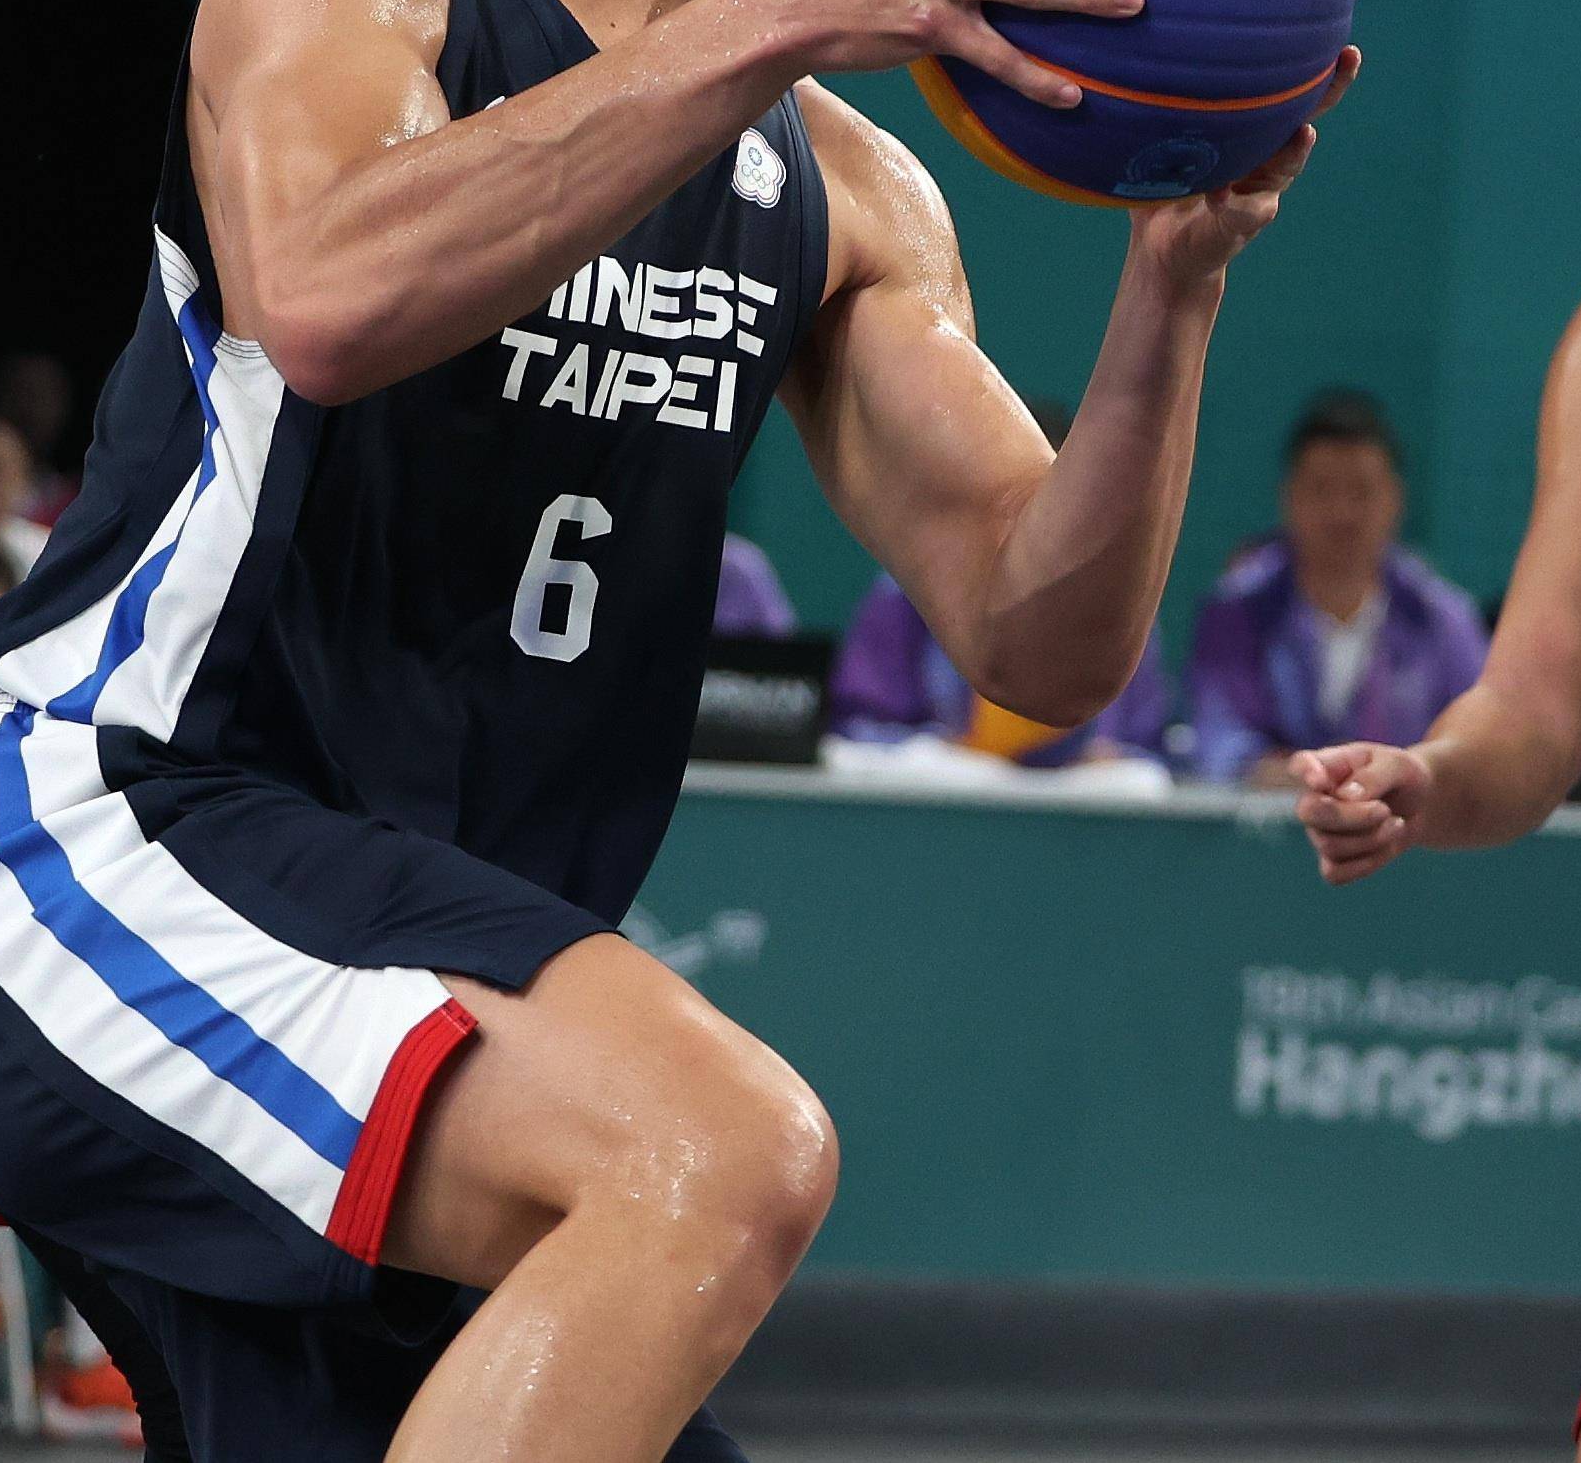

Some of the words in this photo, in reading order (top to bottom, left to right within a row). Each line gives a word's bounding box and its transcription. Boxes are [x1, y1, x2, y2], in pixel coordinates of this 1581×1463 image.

[501, 327, 739, 432] TAIPEI
[510, 494, 612, 662] 6
[1365, 970, 1509, 1036] Asian
